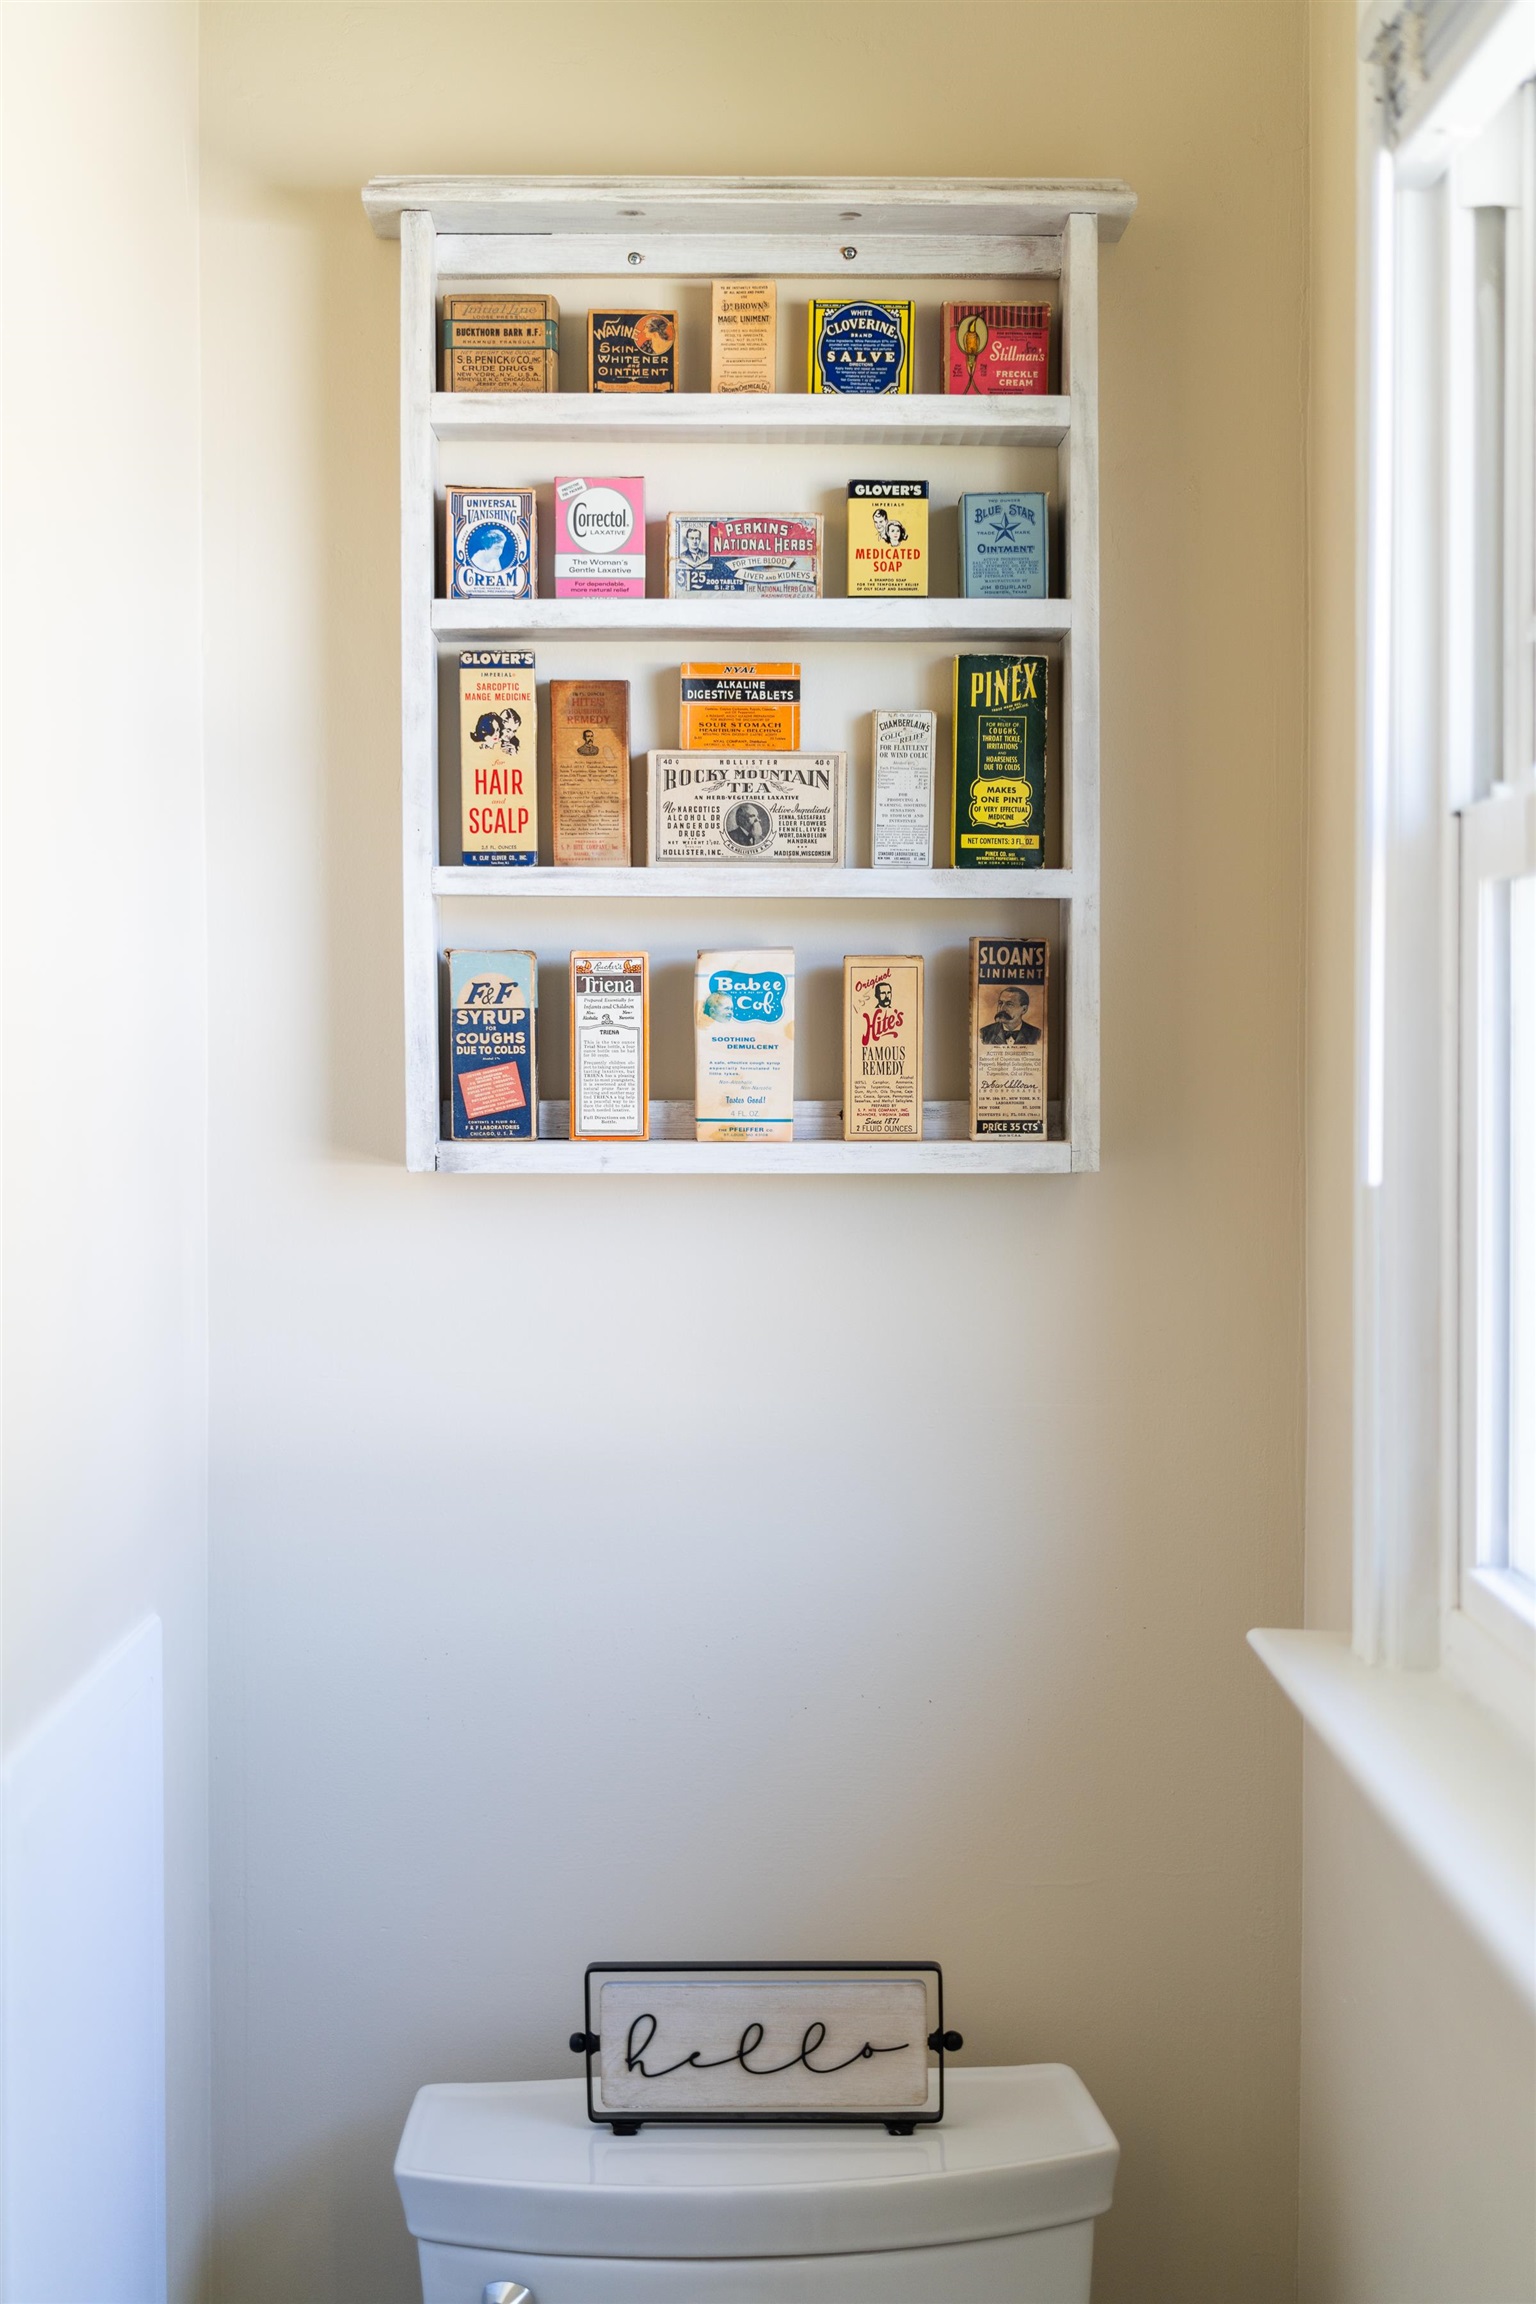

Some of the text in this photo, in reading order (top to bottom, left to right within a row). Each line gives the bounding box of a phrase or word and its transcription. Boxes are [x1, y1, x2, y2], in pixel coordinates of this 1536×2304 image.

[740, 315, 770, 323] LINIMENT
[456, 328, 541, 336] BUCKTHORN BARK N.F.
[594, 317, 641, 341] WAVINE
[827, 351, 895, 363] SALVE
[990, 341, 1045, 361] Stillman's
[475, 356, 510, 364] PENICK
[598, 354, 669, 363] WHITENER
[598, 367, 668, 376] OINTMENT
[855, 485, 922, 496] GLOVER'S
[468, 509, 517, 525] VANISHING
[573, 502, 626, 537] Correctol
[974, 504, 1035, 525] BLUE STAR
[714, 537, 814, 553] NATIONAL HERBS
[977, 544, 1034, 553] OINTMENT
[856, 549, 920, 559] MEDICATED
[732, 559, 746, 569] FOR
[873, 561, 902, 572] SOAP
[463, 568, 518, 587] CREAM
[743, 572, 764, 580] LIVER
[757, 584, 799, 593] NATIONAL HERB
[461, 653, 533, 664] GLOVER'S
[717, 681, 765, 689] ALKALINE
[971, 662, 1038, 707] PINEX
[465, 693, 531, 701] MANGE MEDICINE
[687, 690, 794, 700] DIGESTIVE TABLETS
[567, 715, 610, 724] REMEDY
[879, 719, 930, 732] CHAMBERLAIN'S
[880, 731, 924, 743] COLIC RELIEF
[475, 769, 523, 795] HAIR
[663, 769, 830, 791] ROCKY MOUNTAIN
[726, 782, 771, 793] TEA
[663, 801, 677, 813] No
[770, 803, 830, 814] Active Ingredients
[469, 808, 529, 833] SCALP
[980, 947, 1043, 965] SLOAN'S
[980, 968, 1043, 979] LINIMENT
[581, 976, 634, 993] Triena
[714, 977, 782, 991] Babee
[855, 968, 891, 992] Original
[464, 982, 518, 1005] F&F
[737, 991, 774, 1014] Cof
[457, 1010, 525, 1025] SYRUP
[862, 1008, 904, 1046] Hite's
[456, 1032, 526, 1044] COUGHS
[457, 1046, 526, 1054] DUE TO COLDS
[862, 1046, 906, 1060] FAMOUS
[863, 1061, 904, 1075] REMEDY
[726, 1096, 766, 1104] Tastes Good!
[983, 1123, 1038, 1131] PRICE 35 CTS
[624, 2013, 909, 2078] hello
